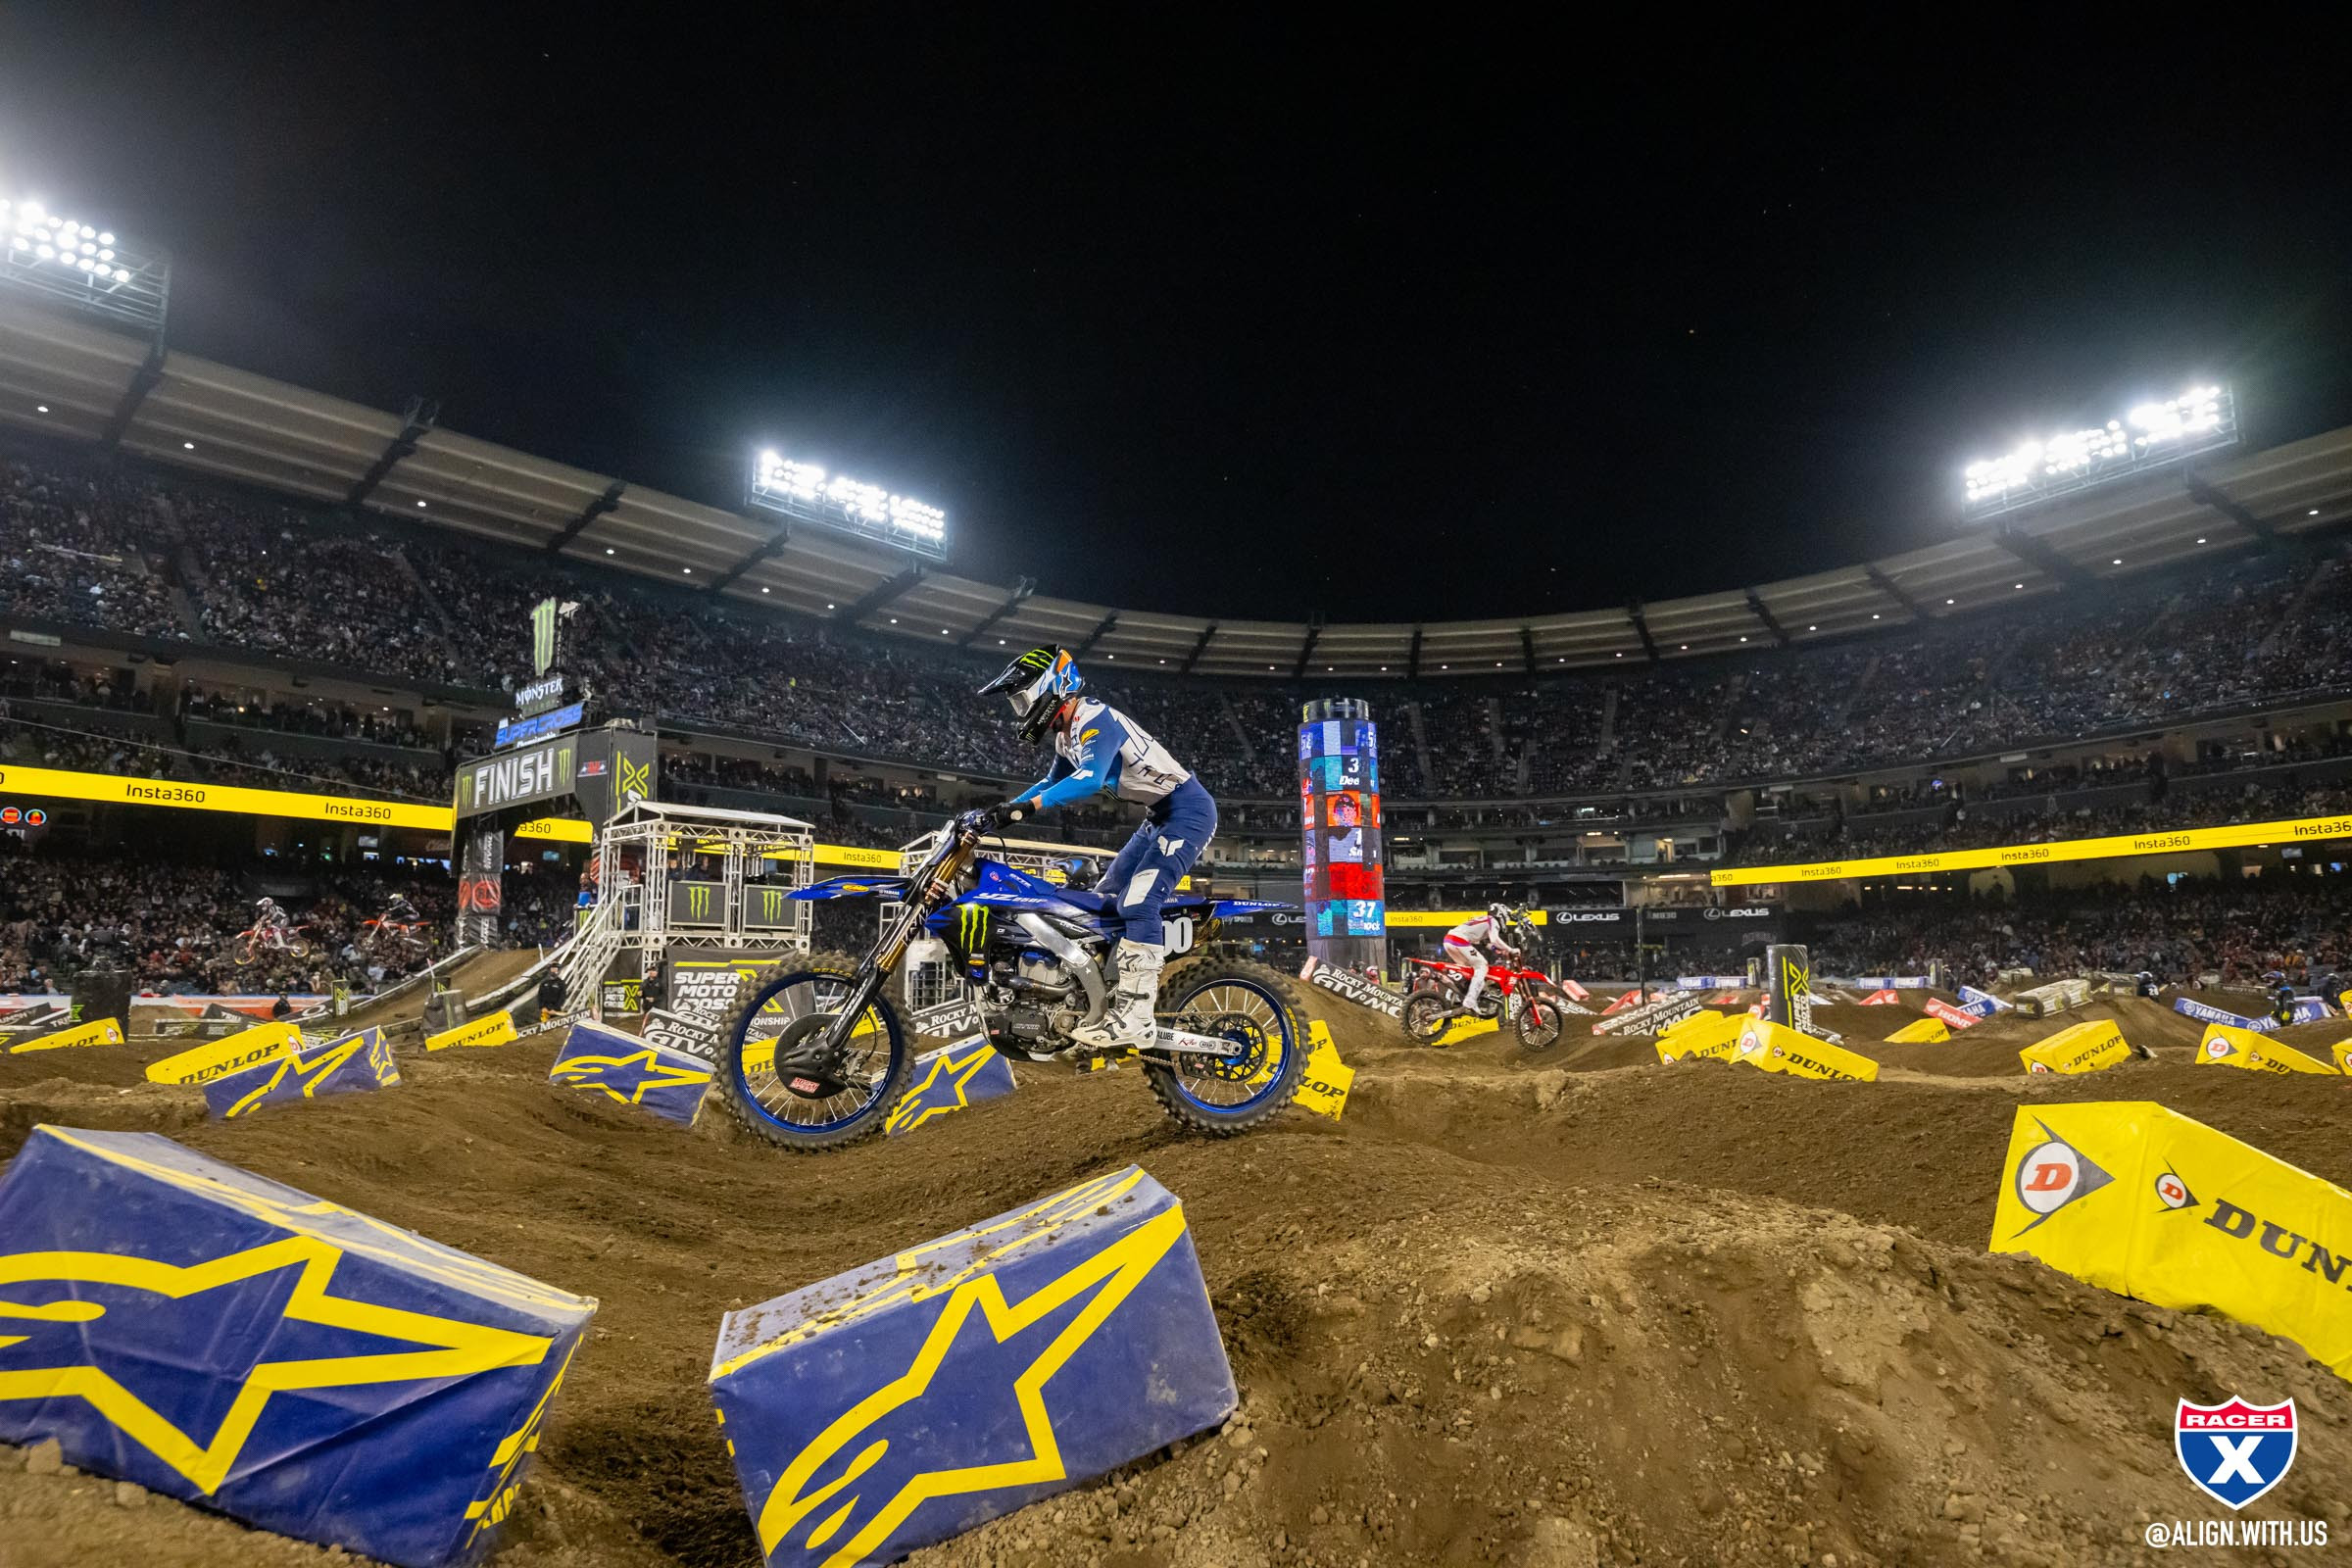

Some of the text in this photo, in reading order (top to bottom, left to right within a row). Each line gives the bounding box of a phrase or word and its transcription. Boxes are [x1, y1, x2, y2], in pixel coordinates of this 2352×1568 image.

[515, 677, 564, 706] MONSTER
[474, 748, 555, 808] FINISH
[126, 784, 206, 804] Insta360
[324, 803, 392, 820] Insta360
[2133, 835, 2190, 851] Insta360
[844, 852, 882, 863] Insta360
[1895, 858, 1939, 869] Insta360
[2000, 848, 2050, 861] Insta360
[1800, 866, 1841, 877] Insta360
[1353, 901, 1376, 918] 37
[1573, 912, 1620, 922] LEXUS
[1722, 907, 1770, 917] LEXUS
[674, 971, 742, 985] SUPER
[1331, 968, 1362, 989] ROCKY
[677, 985, 738, 998] MOTO
[539, 1009, 591, 1034] MOUNTAIN
[931, 1007, 966, 1026] ROCKY
[1623, 1016, 1652, 1035] ROCKY
[1652, 997, 1699, 1024] MOUNTAIN
[2195, 1004, 2235, 1026] YAMAHA
[666, 1020, 710, 1041] ROCKY
[2073, 1034, 2123, 1067] DUNLOP
[2203, 1198, 2352, 1293] DUN
